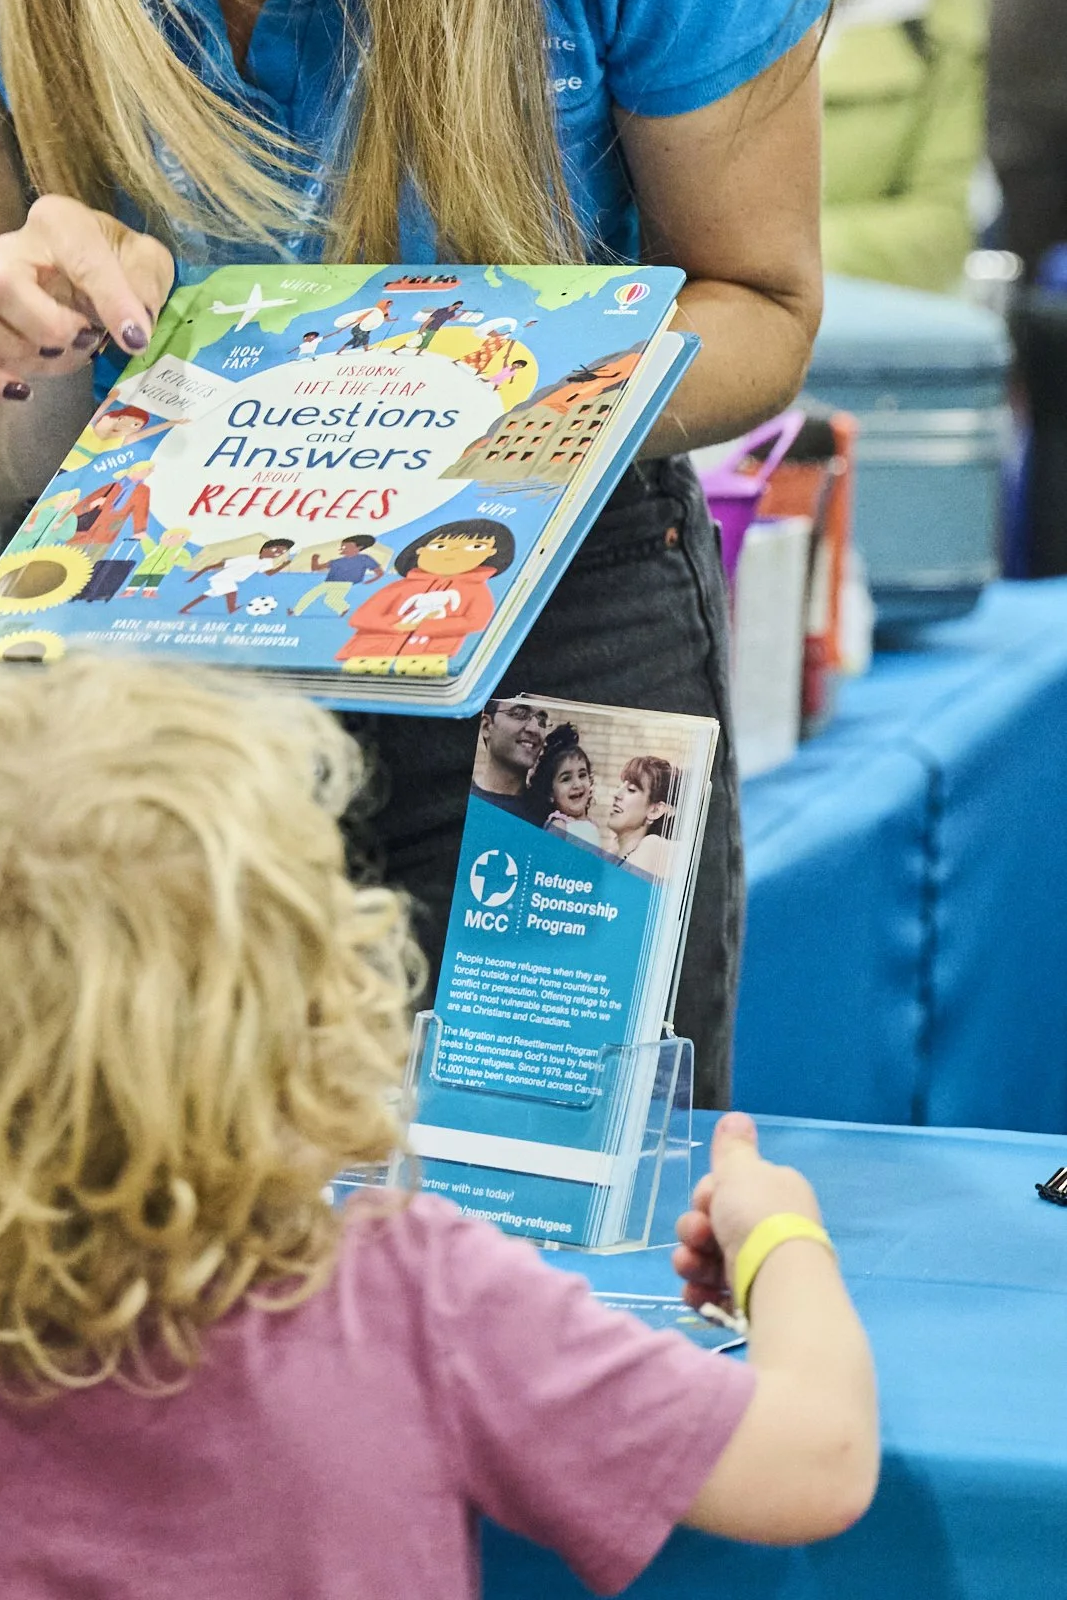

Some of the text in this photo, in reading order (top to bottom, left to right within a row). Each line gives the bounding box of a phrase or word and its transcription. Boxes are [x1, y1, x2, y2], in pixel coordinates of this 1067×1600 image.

[280, 279, 332, 295] WHERE?
[222, 357, 260, 369] FAR?
[230, 345, 264, 358] HOW
[336, 365, 406, 377] USBORNE
[156, 369, 217, 398] REFUGEES
[294, 380, 427, 396] LIFT-THE-FLAP
[139, 383, 196, 411] WELCOME
[227, 399, 460, 429] Questions
[306, 430, 356, 443] and
[93, 450, 134, 473] WHO?
[203, 436, 432, 470] Answers
[252, 471, 304, 484] ABOUT
[188, 484, 398, 522] REFUGEES
[476, 501, 516, 520] WHY?
[86, 631, 151, 642] ILLUSTRATED
[154, 632, 173, 643] BY
[174, 633, 218, 645] OKSANA
[111, 619, 142, 630] KATIE
[233, 623, 249, 633] DE
[251, 623, 287, 634] SOUSA
[534, 871, 593, 894] Refugee
[531, 893, 618, 922] Sponsorship
[464, 910, 509, 932] MCC
[526, 914, 586, 936] Program
[456, 952, 606, 982] People become refugees when they are
[454, 964, 611, 998] forced outside of their home countries by
[452, 978, 480, 989] conflict
[492, 984, 538, 998] persecution.
[541, 990, 571, 1004] Offering
[573, 995, 598, 1008] refuge
[600, 999, 607, 1008] to
[609, 1000, 621, 1010] the
[447, 1002, 572, 1028] are as Christians and Canadians.
[480, 995, 499, 1005] most
[501, 998, 540, 1010] vulnerable
[542, 1003, 569, 1016] speaks
[571, 1007, 579, 1016] to
[581, 1010, 596, 1019] who
[599, 1013, 611, 1021] we
[444, 1026, 598, 1057] The Migration and Resettlement Program
[438, 1051, 587, 1081] to sponsor refugees. Since 1979, about
[441, 1040, 463, 1050] seeks
[465, 1043, 473, 1051] to
[475, 1044, 523, 1058] demonstrate
[549, 1054, 565, 1065] love
[567, 1057, 577, 1068] by
[438, 1062, 462, 1075] 14,000
[464, 1066, 482, 1078] have
[484, 1070, 503, 1081] been
[505, 1073, 546, 1088] sponsored
[547, 1080, 572, 1091] across
[452, 1182, 470, 1194] with
[473, 1187, 484, 1195] us
[486, 1189, 515, 1203] today!
